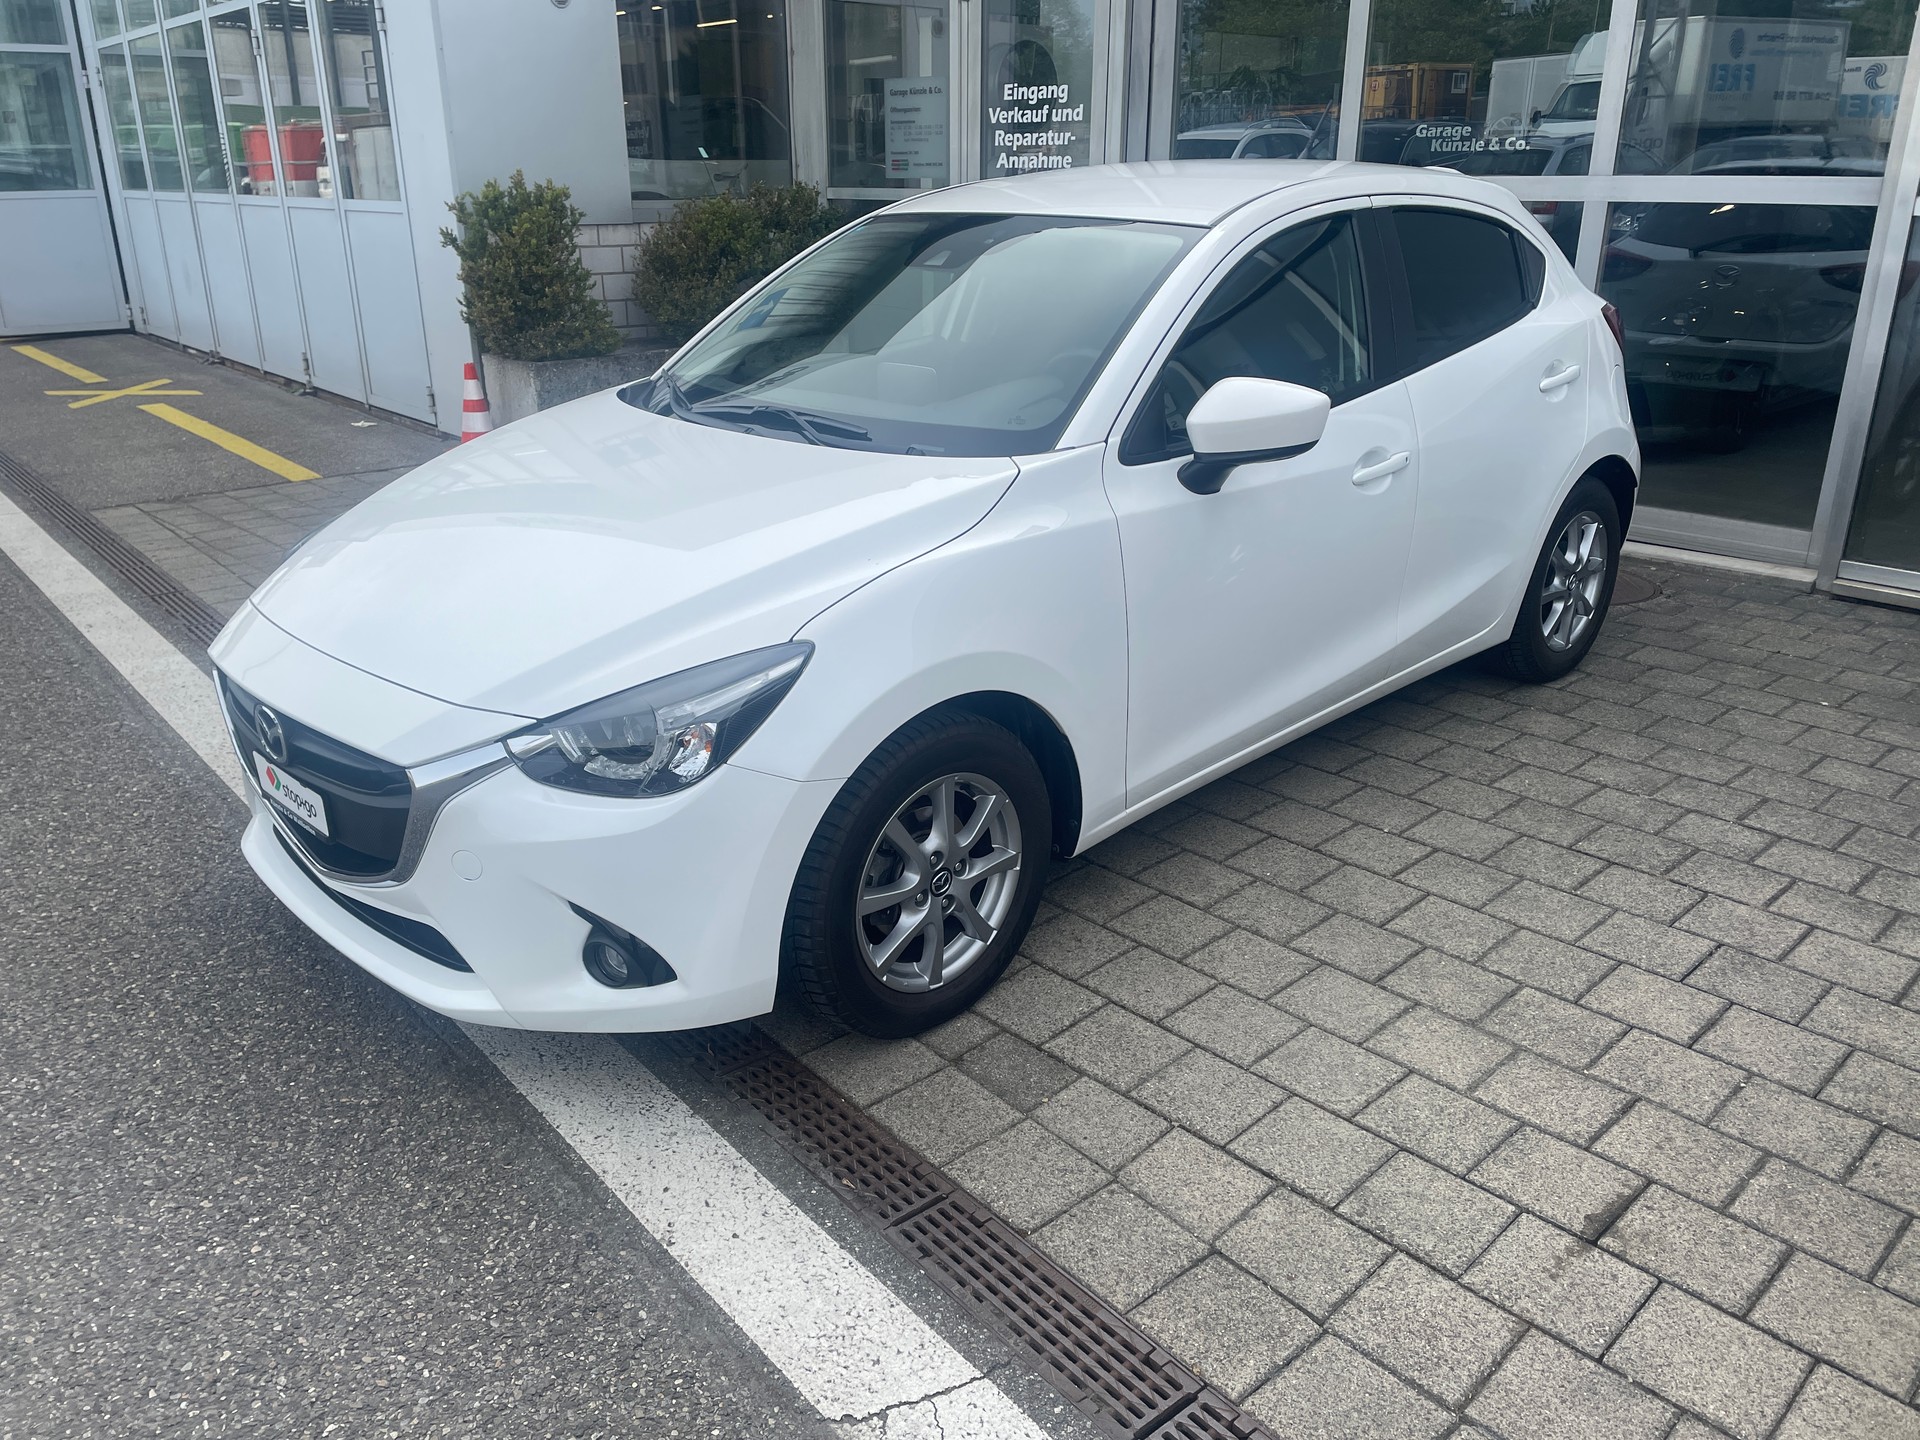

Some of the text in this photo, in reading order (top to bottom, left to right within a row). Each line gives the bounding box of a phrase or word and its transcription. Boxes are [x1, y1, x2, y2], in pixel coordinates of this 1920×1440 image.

[890, 89, 908, 97] Garage
[910, 87, 927, 95] Künzle
[1003, 83, 1069, 105] Eingang
[988, 104, 1084, 124] Verkauf und
[994, 129, 1076, 150] Reparatur-
[1416, 123, 1472, 142] Garage
[1430, 136, 1530, 153] Künzle & Co.
[996, 153, 1072, 169] Annahme
